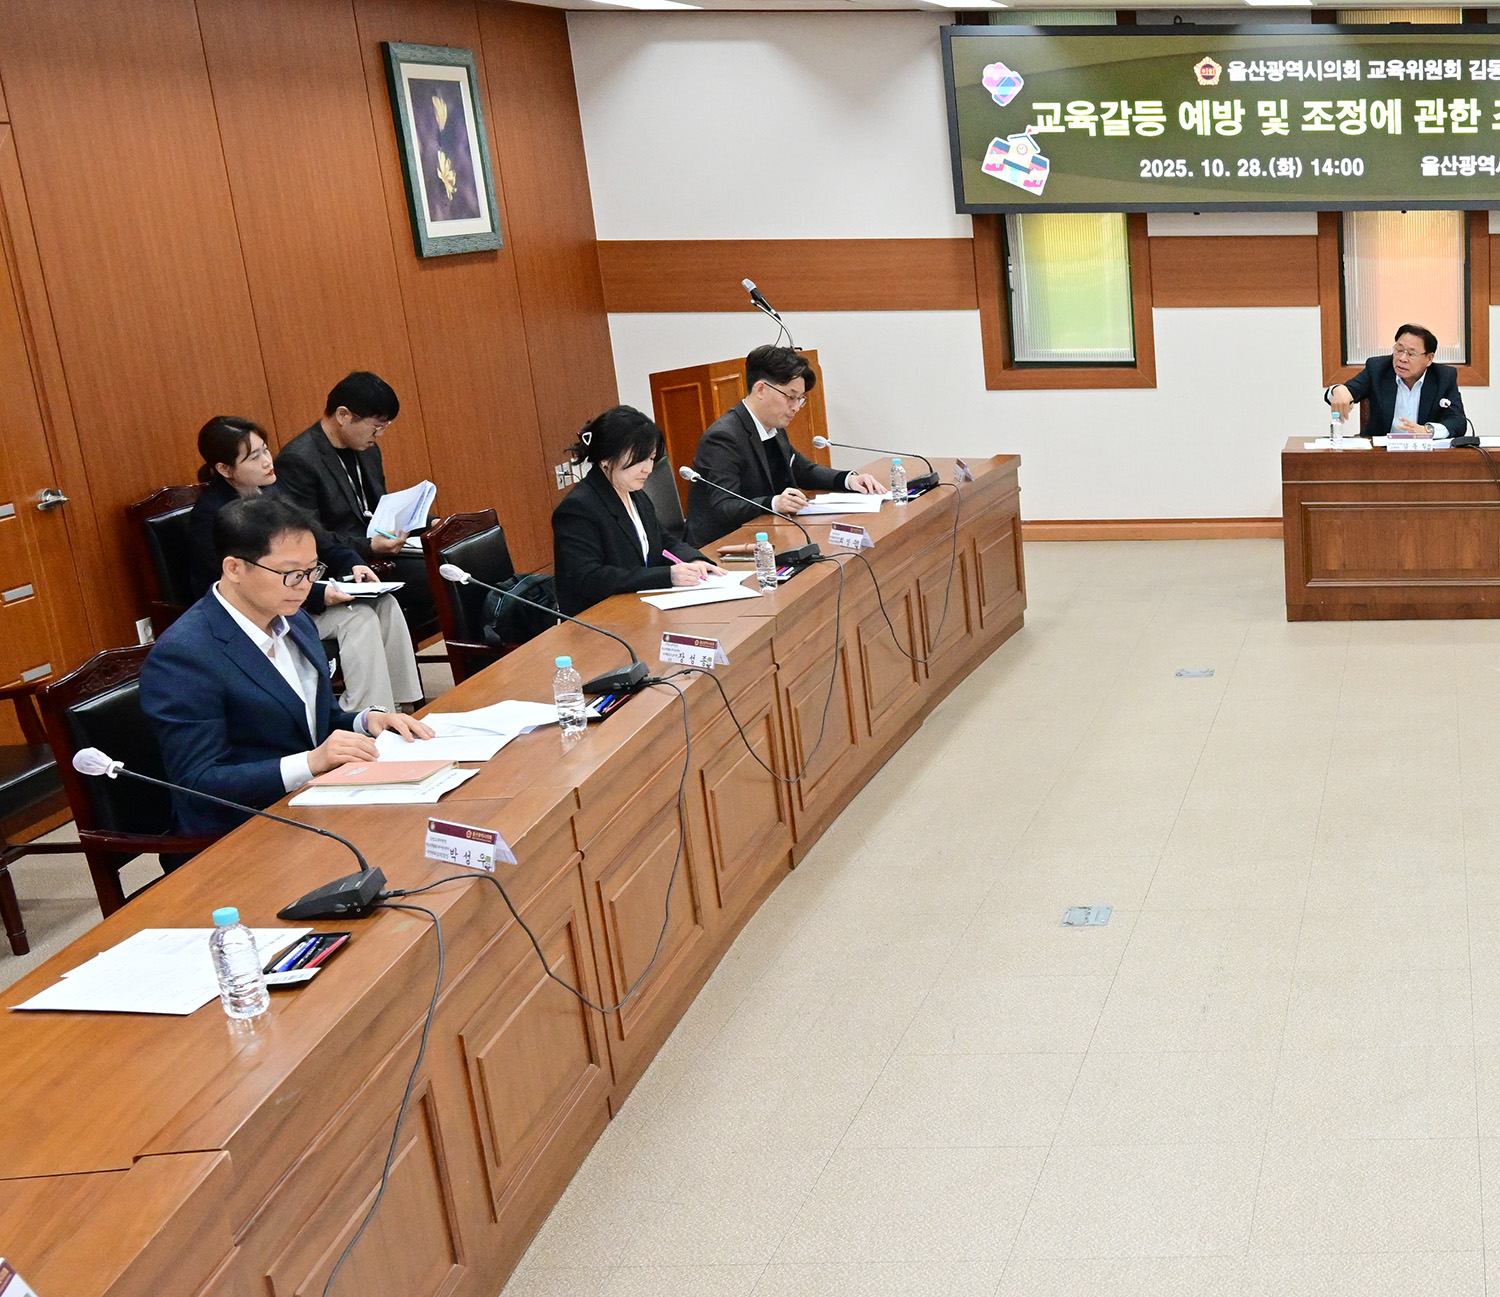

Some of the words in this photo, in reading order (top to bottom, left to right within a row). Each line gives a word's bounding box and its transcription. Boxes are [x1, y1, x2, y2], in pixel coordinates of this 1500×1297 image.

[1227, 60, 1361, 82] 울산광역시의회
[1367, 59, 1462, 81] 교육위원회
[1031, 100, 1167, 137] 교육갈등
[1178, 99, 1246, 136] 예방
[1258, 99, 1291, 136] 및
[1301, 98, 1402, 136] 조정에
[1414, 98, 1482, 134] 관한
[1139, 159, 1194, 178] 2025.
[1201, 158, 1231, 178] 10.
[1237, 157, 1303, 178] 28.(화)
[1310, 157, 1365, 177] 14:00
